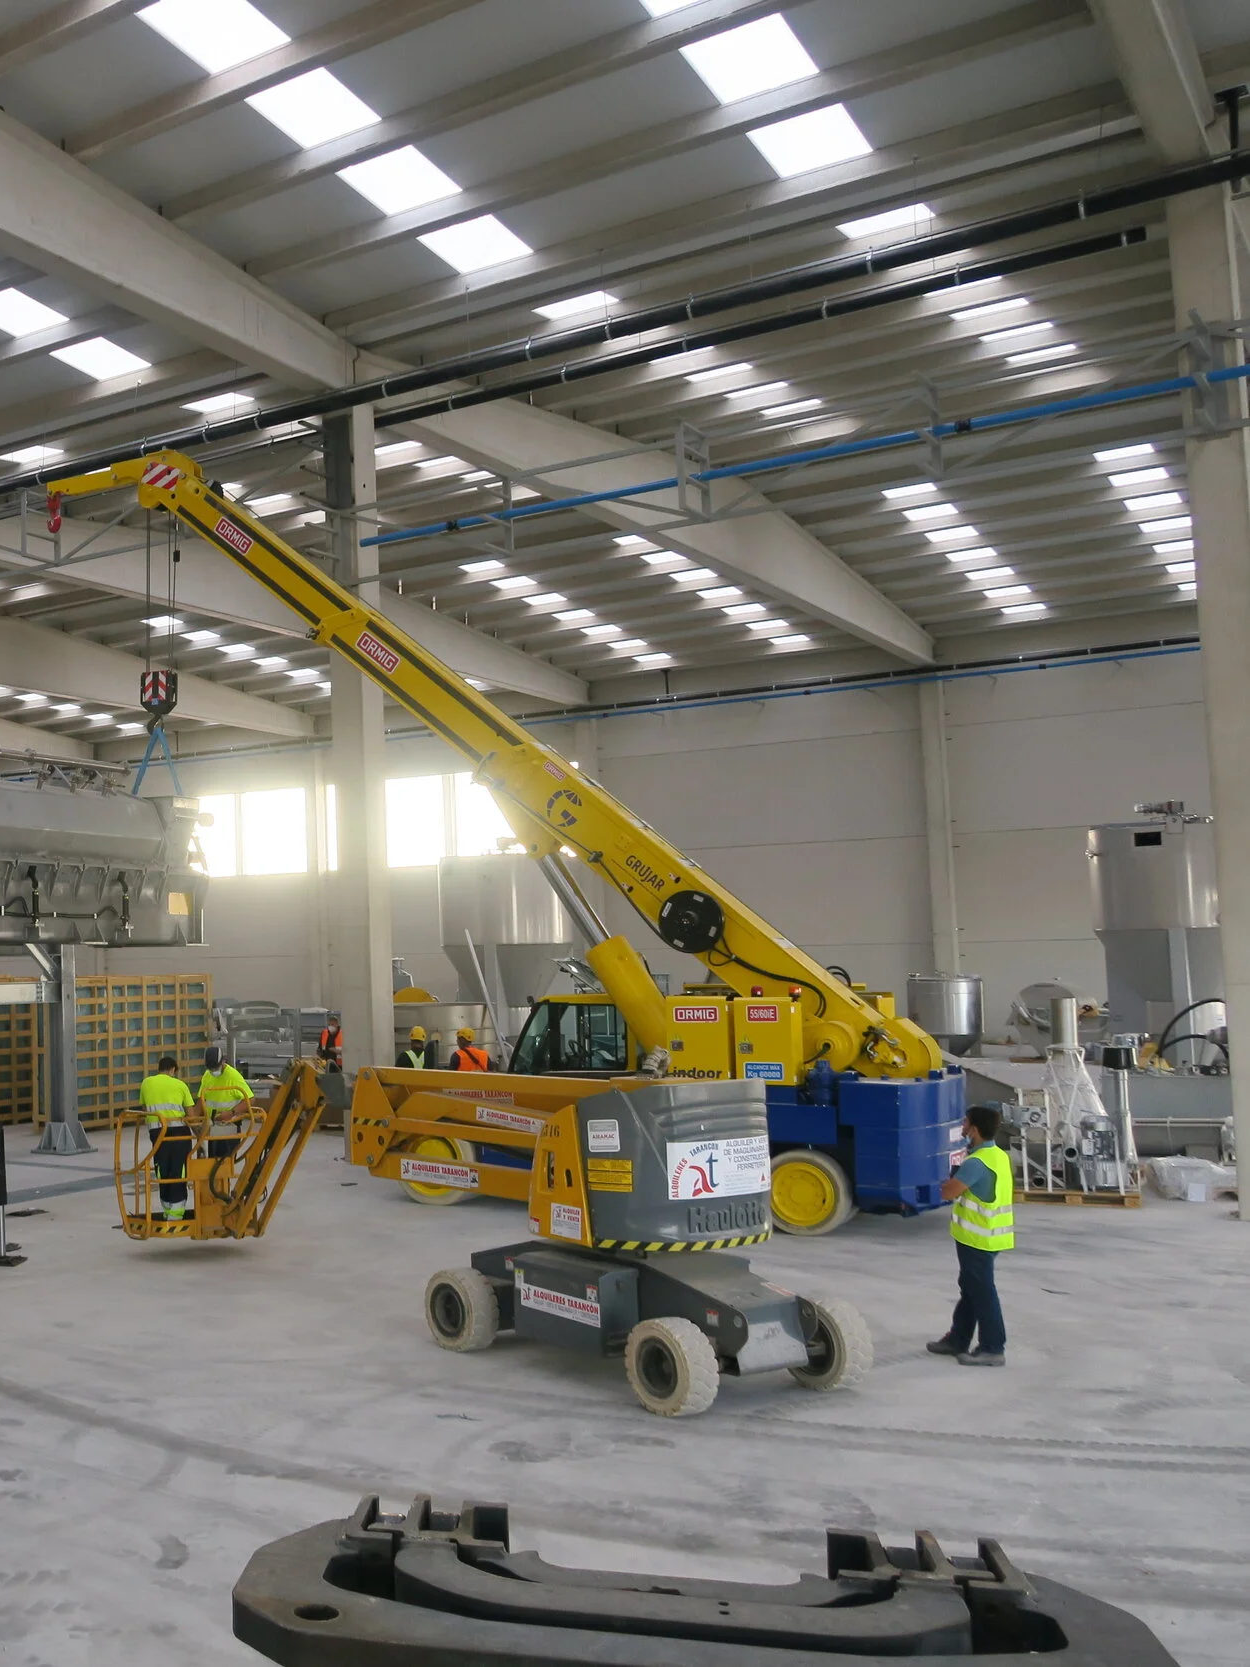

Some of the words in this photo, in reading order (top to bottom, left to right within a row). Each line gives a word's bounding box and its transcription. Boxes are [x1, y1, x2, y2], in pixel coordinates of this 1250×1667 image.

[218, 520, 251, 552] ORMIG
[359, 636, 398, 670] ORMIG
[544, 762, 565, 780] ORMIG
[625, 855, 666, 892] GRUJAR
[676, 1009, 715, 1020] ORMIG
[673, 1066, 723, 1079] indoor
[723, 1148, 732, 1156] DE
[411, 1162, 440, 1174] ALQUILERES
[671, 1157, 688, 1198] ALQUILERES
[687, 1200, 766, 1234] Haulotte
[533, 1289, 566, 1305] ALQUILERES
